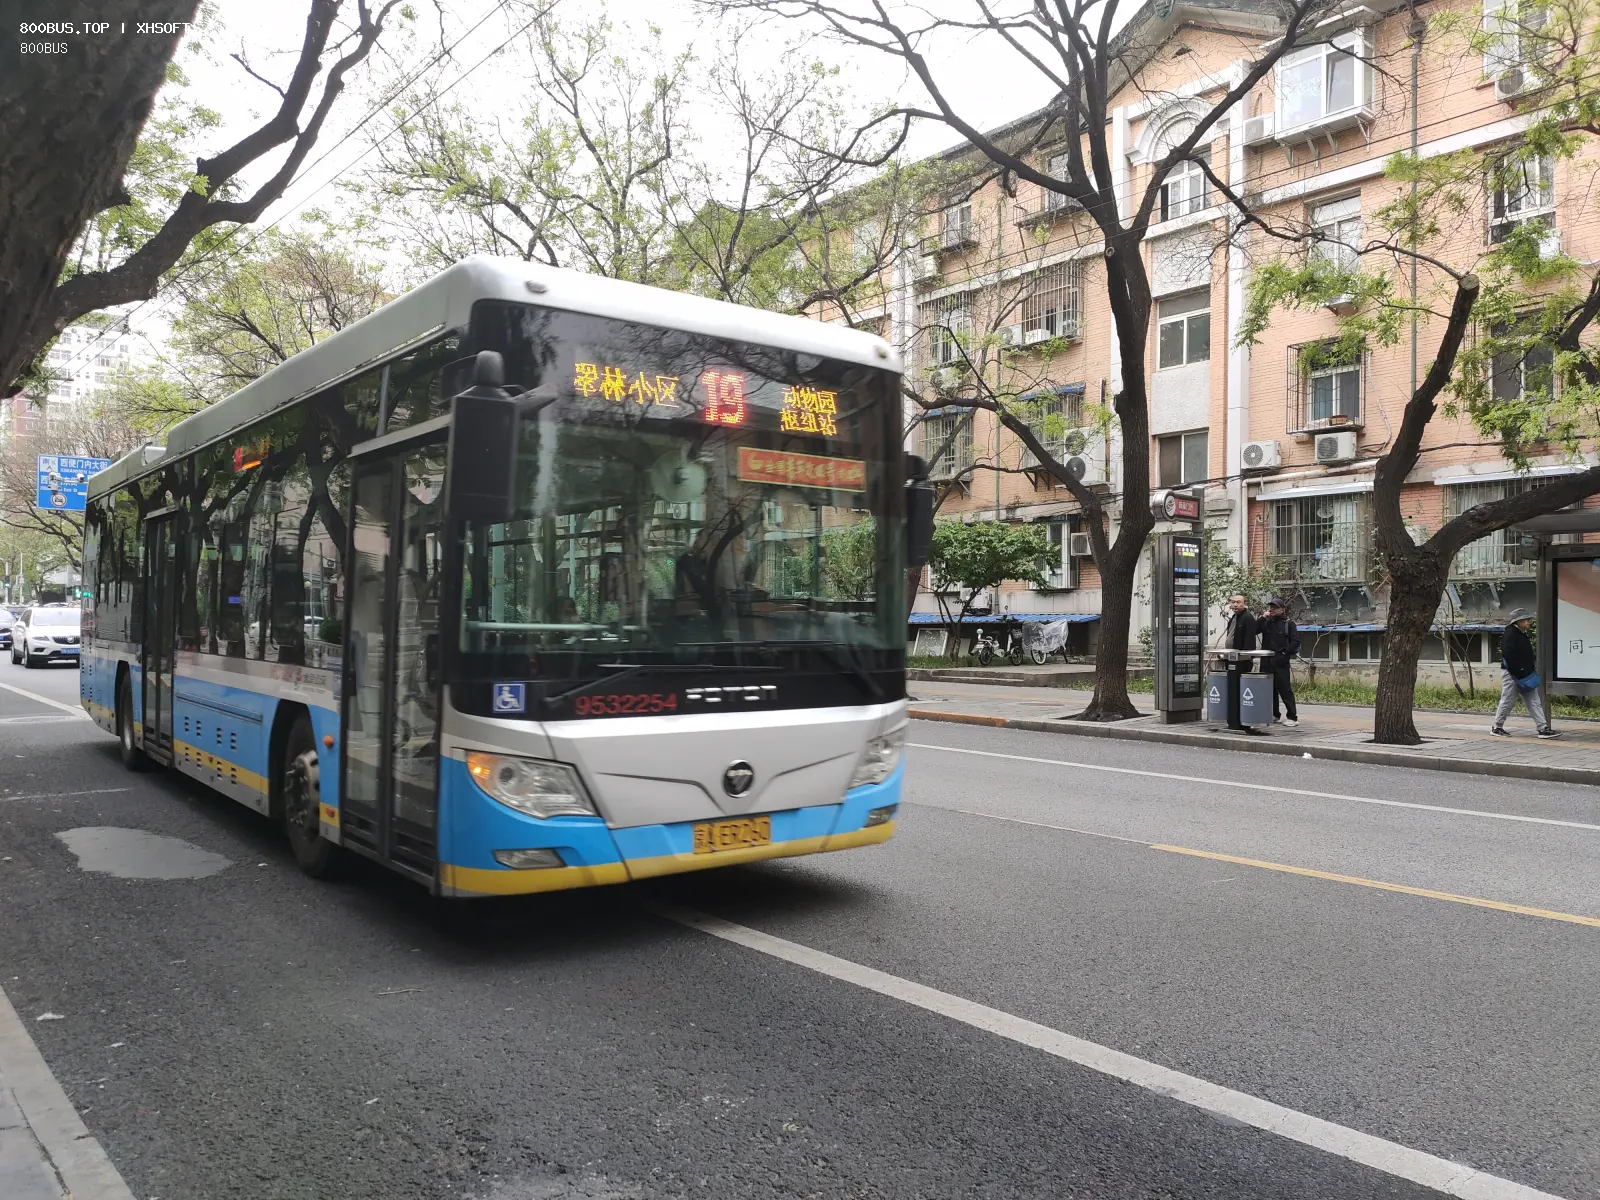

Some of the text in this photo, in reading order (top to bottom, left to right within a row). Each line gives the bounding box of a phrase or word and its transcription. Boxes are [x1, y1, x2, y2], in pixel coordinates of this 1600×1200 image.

[573, 362, 680, 408] 翠林小区
[701, 371, 745, 424] 19
[781, 385, 837, 414] 动物园
[779, 407, 837, 436] 枢纽站
[60, 458, 108, 470] 西便门内大街
[575, 692, 678, 716] 9532254
